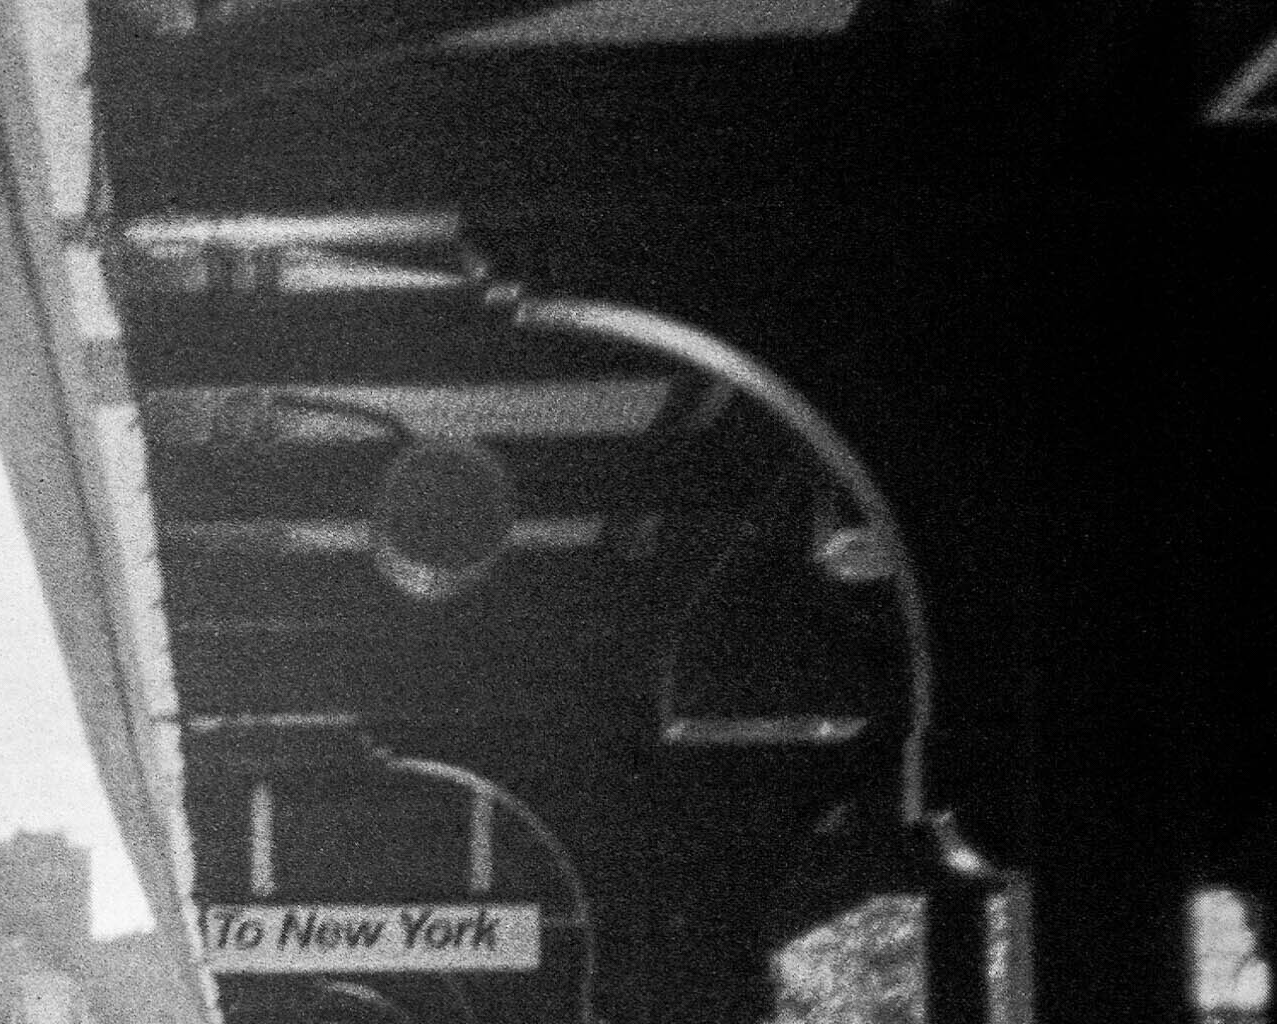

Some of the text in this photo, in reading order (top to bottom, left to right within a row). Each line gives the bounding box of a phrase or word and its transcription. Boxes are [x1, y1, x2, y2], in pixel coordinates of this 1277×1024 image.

[212, 907, 500, 951] To New York
